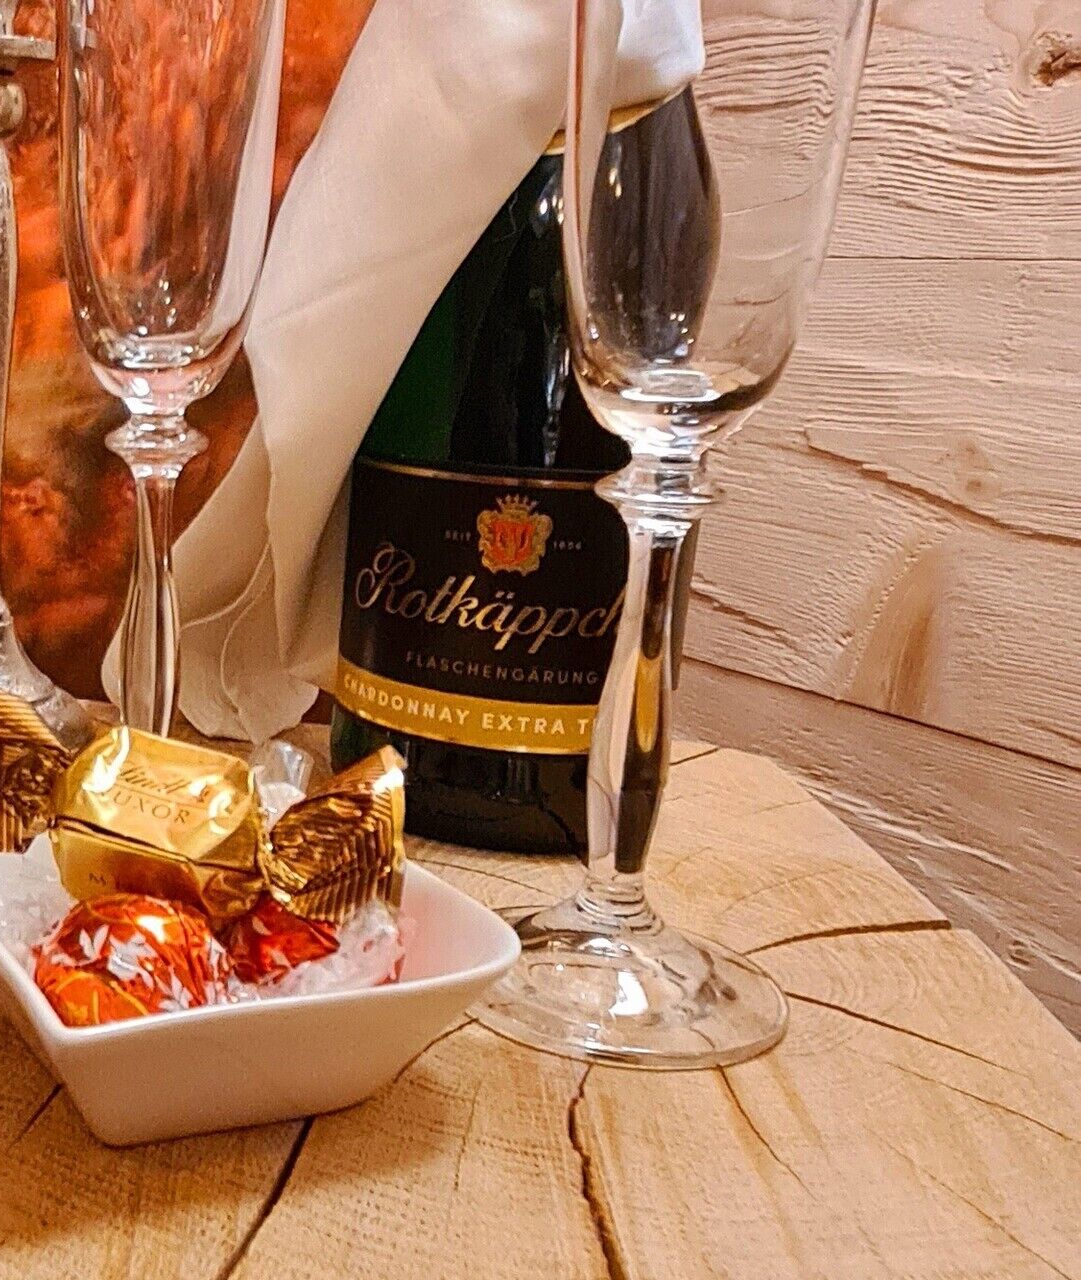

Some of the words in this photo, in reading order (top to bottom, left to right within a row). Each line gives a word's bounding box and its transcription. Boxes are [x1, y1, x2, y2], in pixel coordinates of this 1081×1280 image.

[405, 651, 601, 686] FLASCHENGÄRUNG
[343, 673, 470, 726] CHARDONNAY
[481, 712, 568, 737] EXTRA
[576, 717, 596, 736] T
